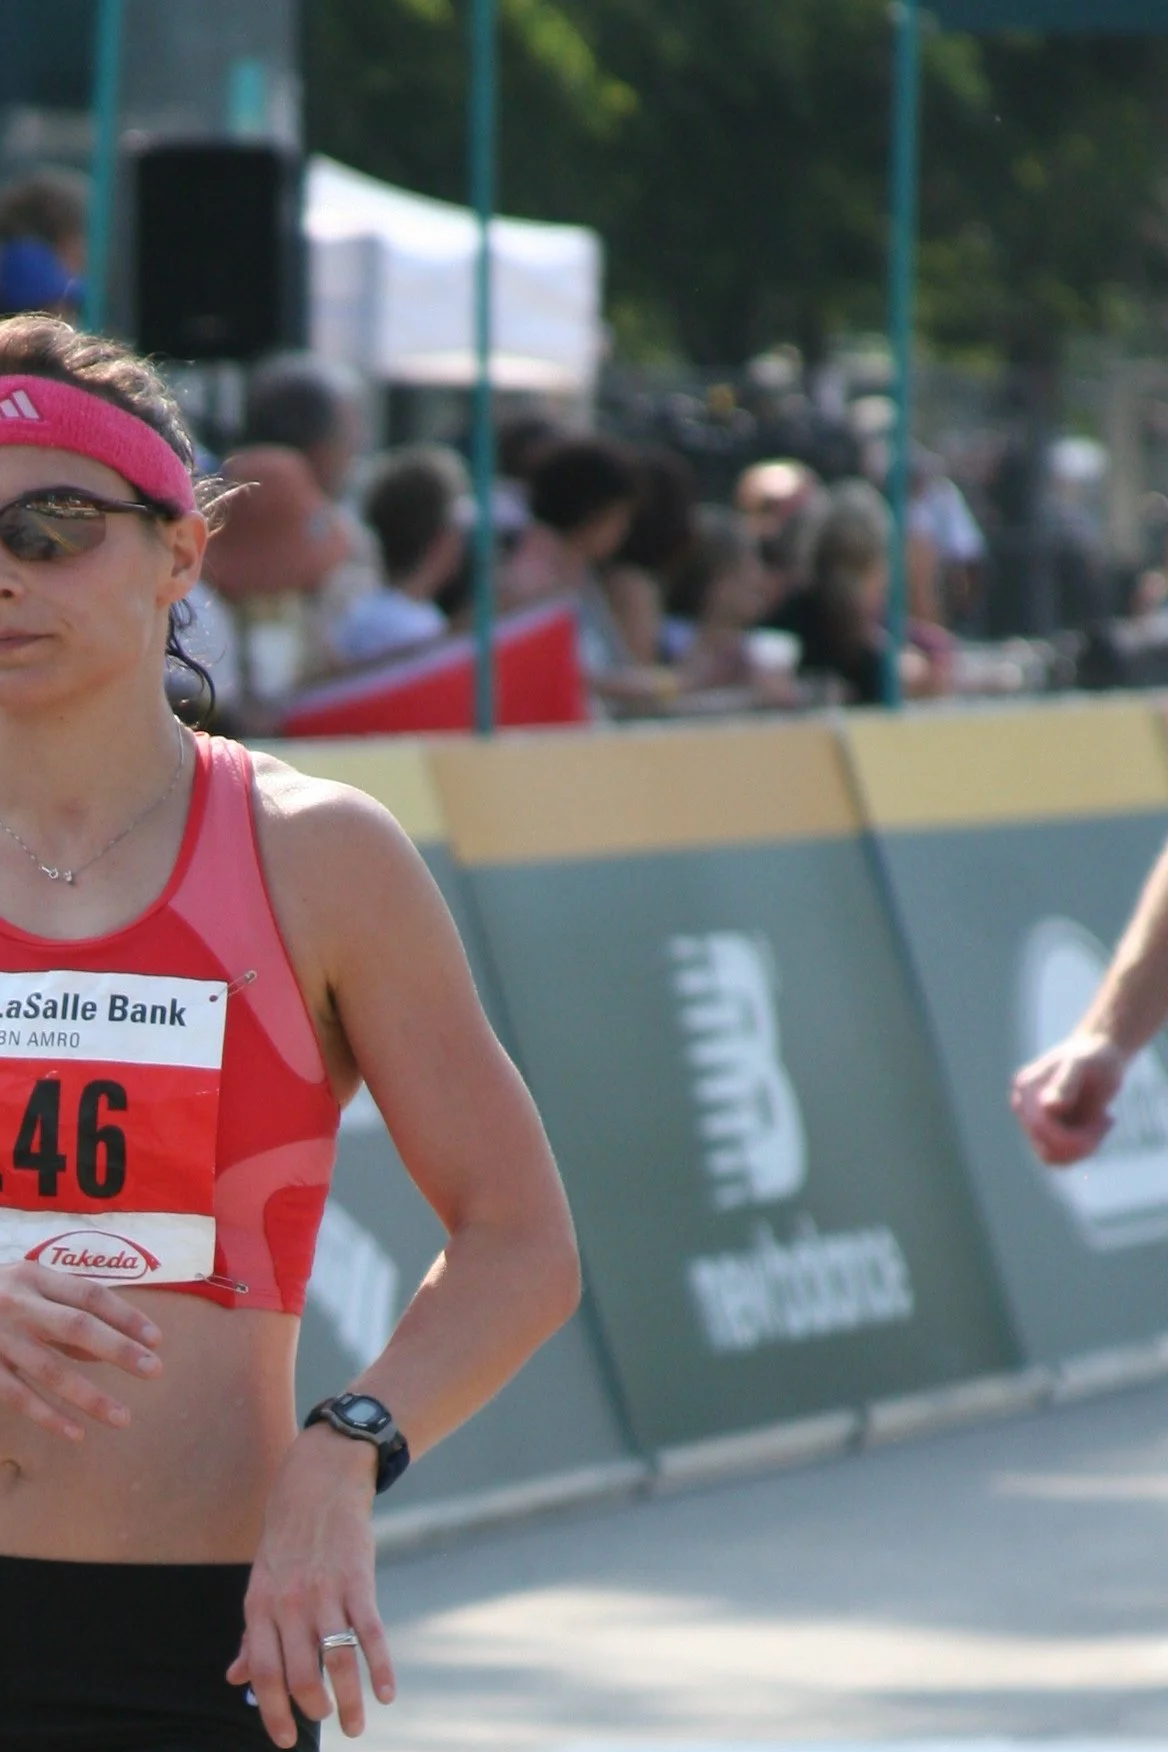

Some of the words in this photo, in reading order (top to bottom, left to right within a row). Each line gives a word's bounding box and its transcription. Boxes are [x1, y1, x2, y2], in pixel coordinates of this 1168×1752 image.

[108, 994, 186, 1027] Bank
[27, 1030, 80, 1048] AMRO
[49, 1246, 139, 1270] Takeda
